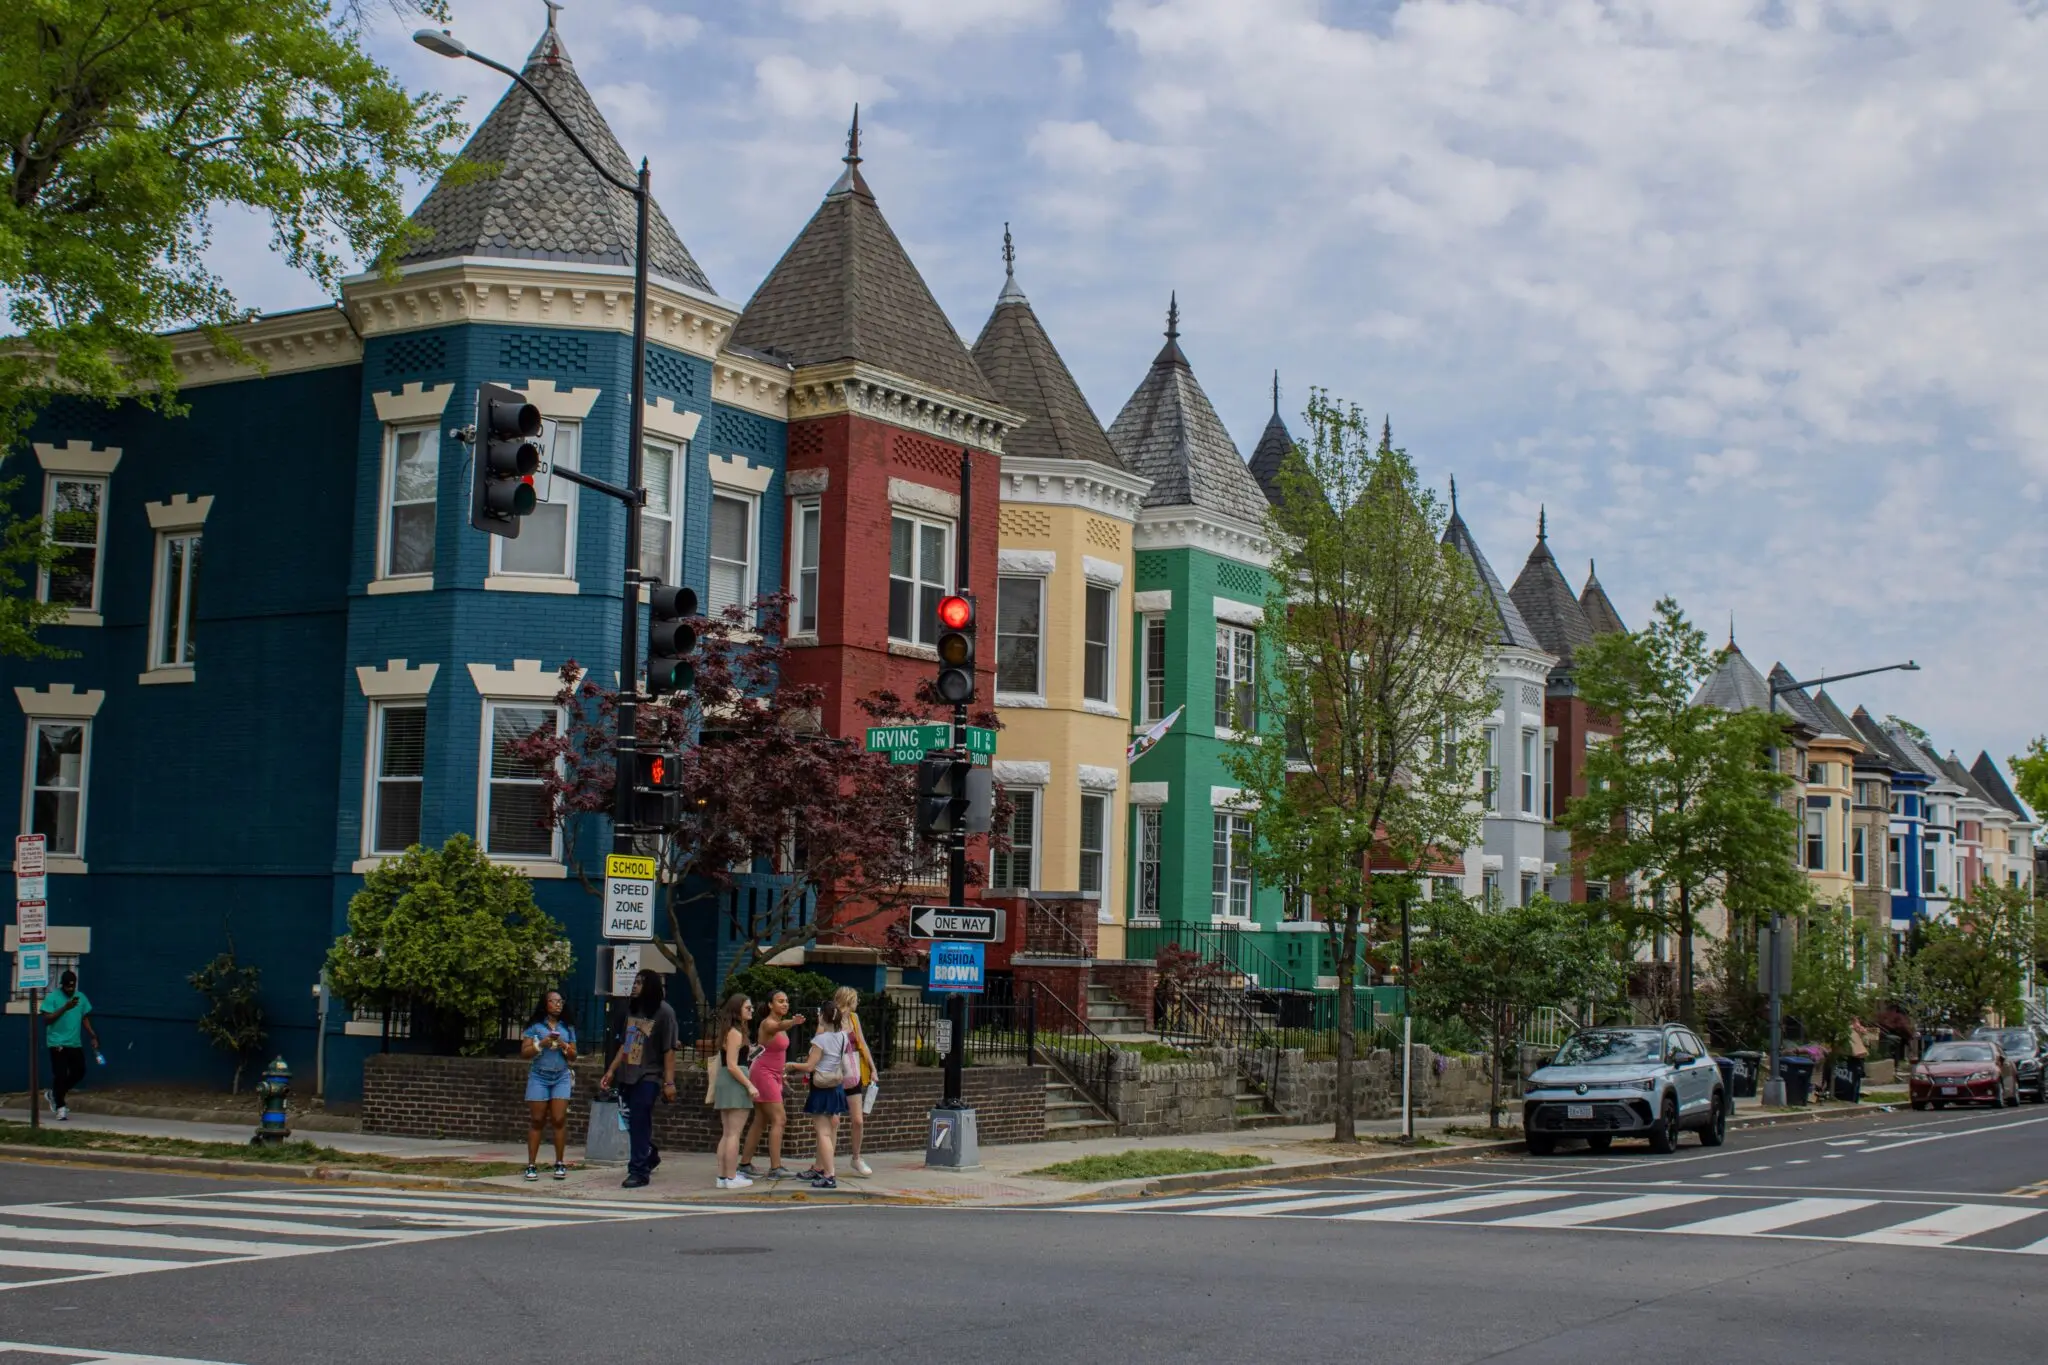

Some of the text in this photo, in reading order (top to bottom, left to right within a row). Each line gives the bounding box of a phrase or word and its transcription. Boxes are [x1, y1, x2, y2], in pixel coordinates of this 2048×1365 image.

[872, 727, 944, 748] IRVING ST
[934, 738, 946, 748] NW
[973, 731, 981, 749] 11
[894, 749, 924, 761] 1000
[971, 752, 988, 766] 3000
[612, 861, 650, 876] SCHOOL
[613, 883, 649, 896] SPEED
[616, 901, 644, 913] ZONE
[611, 919, 648, 931] AHEAD
[935, 917, 986, 931] ONE WAY
[939, 953, 976, 965] RASHIDA
[935, 966, 979, 981] BROWN
